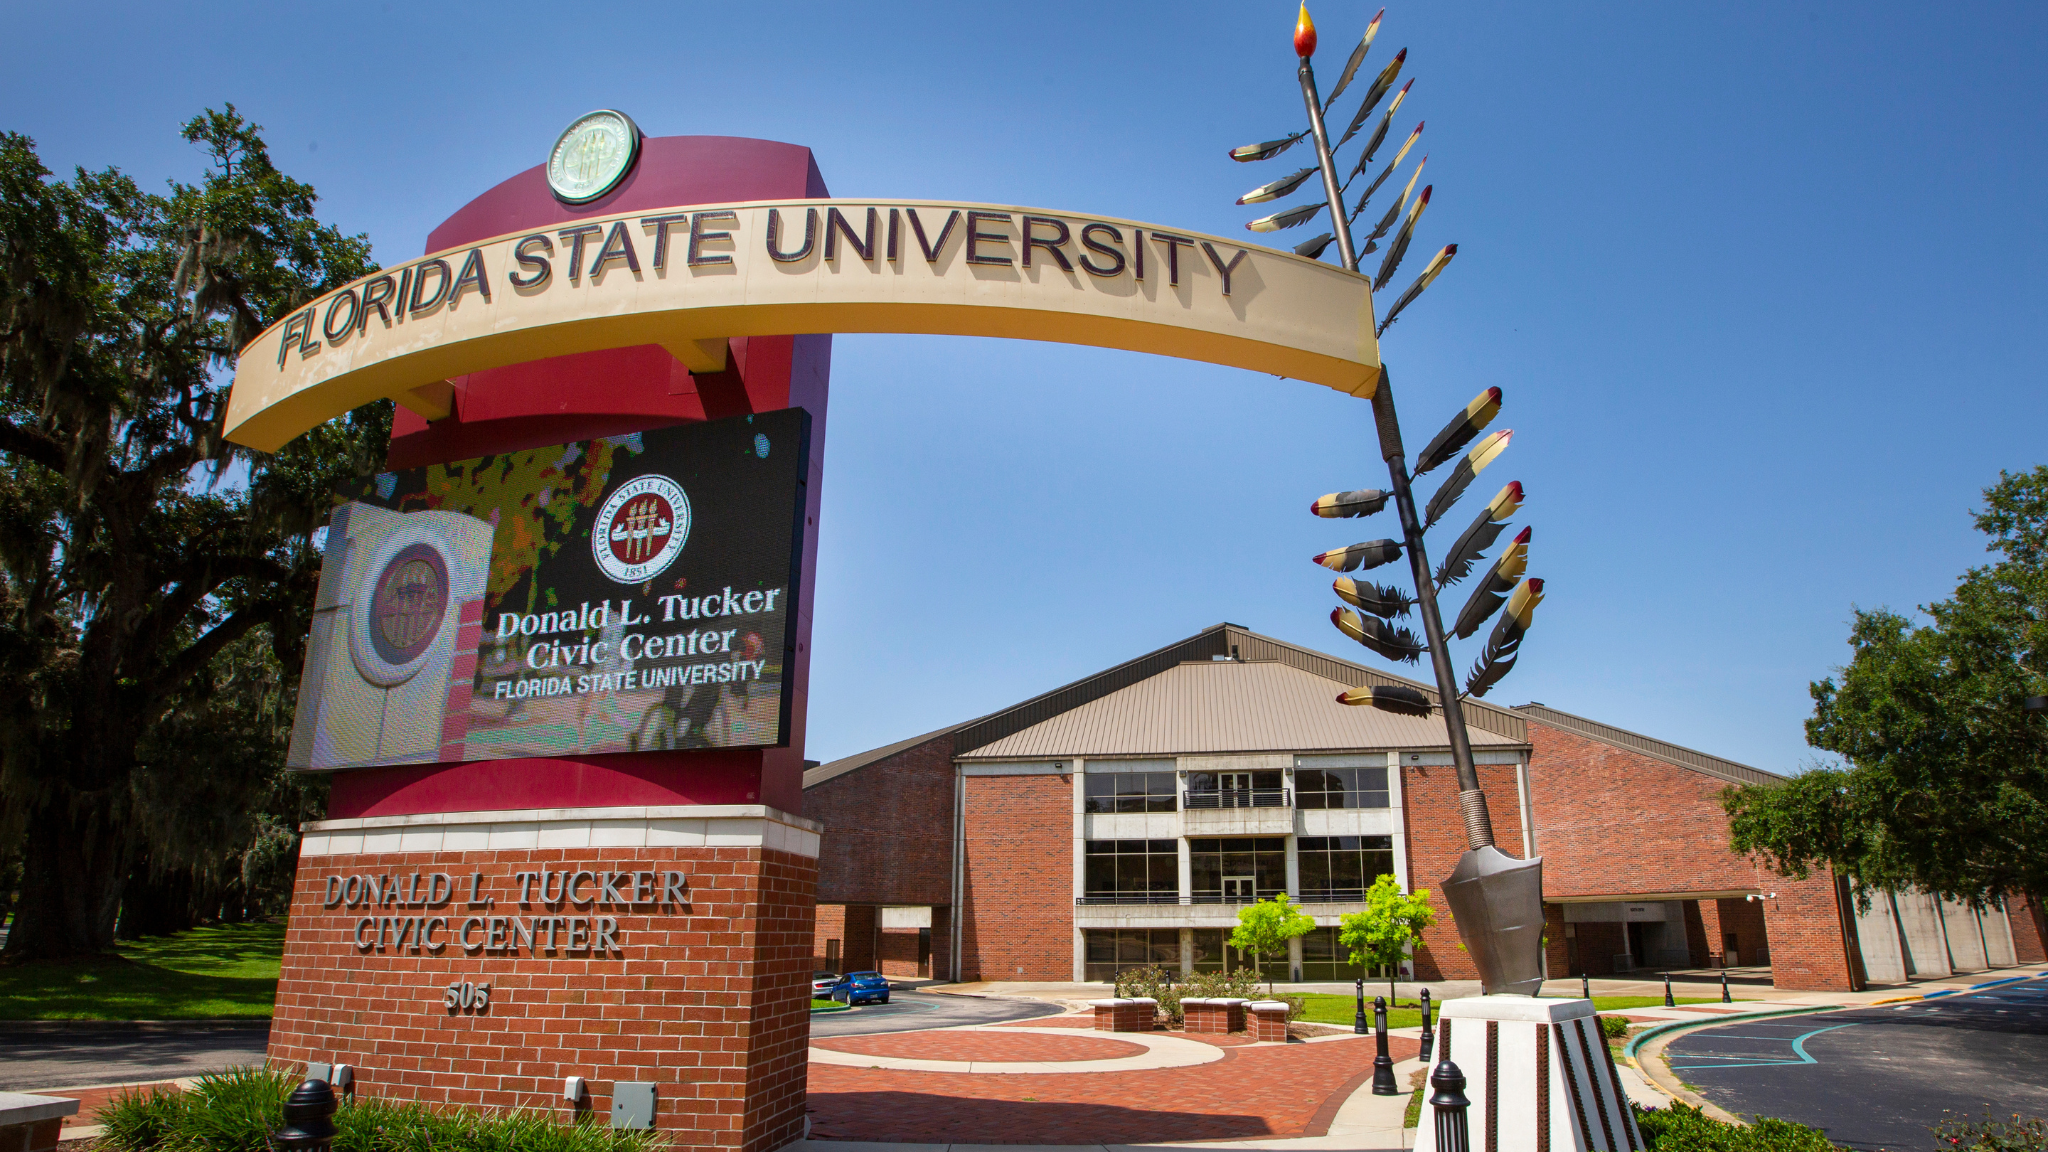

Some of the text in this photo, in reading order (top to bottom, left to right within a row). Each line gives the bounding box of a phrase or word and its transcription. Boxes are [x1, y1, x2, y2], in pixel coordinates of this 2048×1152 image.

[277, 206, 1248, 371] FLORIDA STATE UNIVERSITY
[624, 565, 648, 577] 1851
[496, 586, 781, 639] Donald L. Tucker
[526, 627, 737, 669] Civic Center
[494, 659, 765, 700] FLORIDA STATE UNIVERSITY
[324, 870, 690, 906] DONALD L. TUCKER
[354, 915, 620, 952] CIVIC CENTER
[444, 981, 491, 1010] 505
